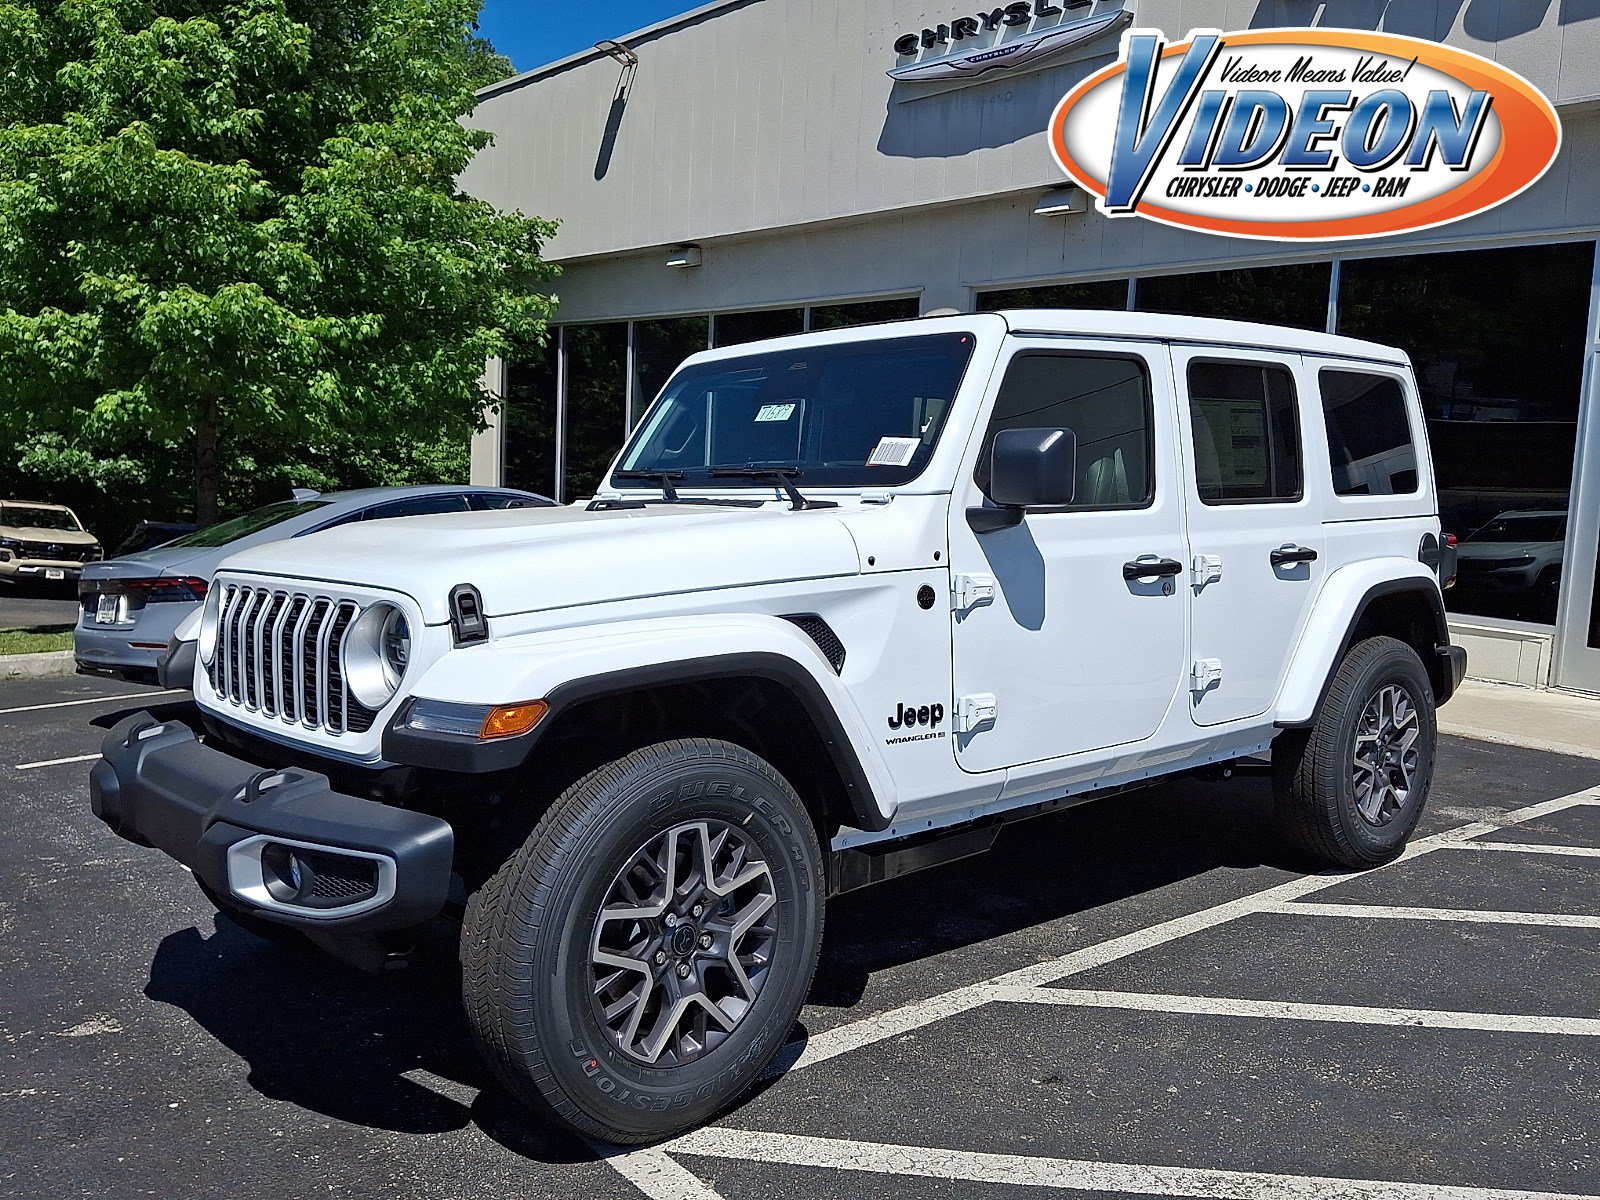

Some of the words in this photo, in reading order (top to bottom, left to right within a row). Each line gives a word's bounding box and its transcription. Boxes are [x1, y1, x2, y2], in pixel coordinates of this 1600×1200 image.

[894, 0, 1110, 56] CHRYSL
[970, 47, 1016, 62] CHRYSLER
[887, 702, 944, 730] Jeep
[885, 732, 937, 746] WRANGLER
